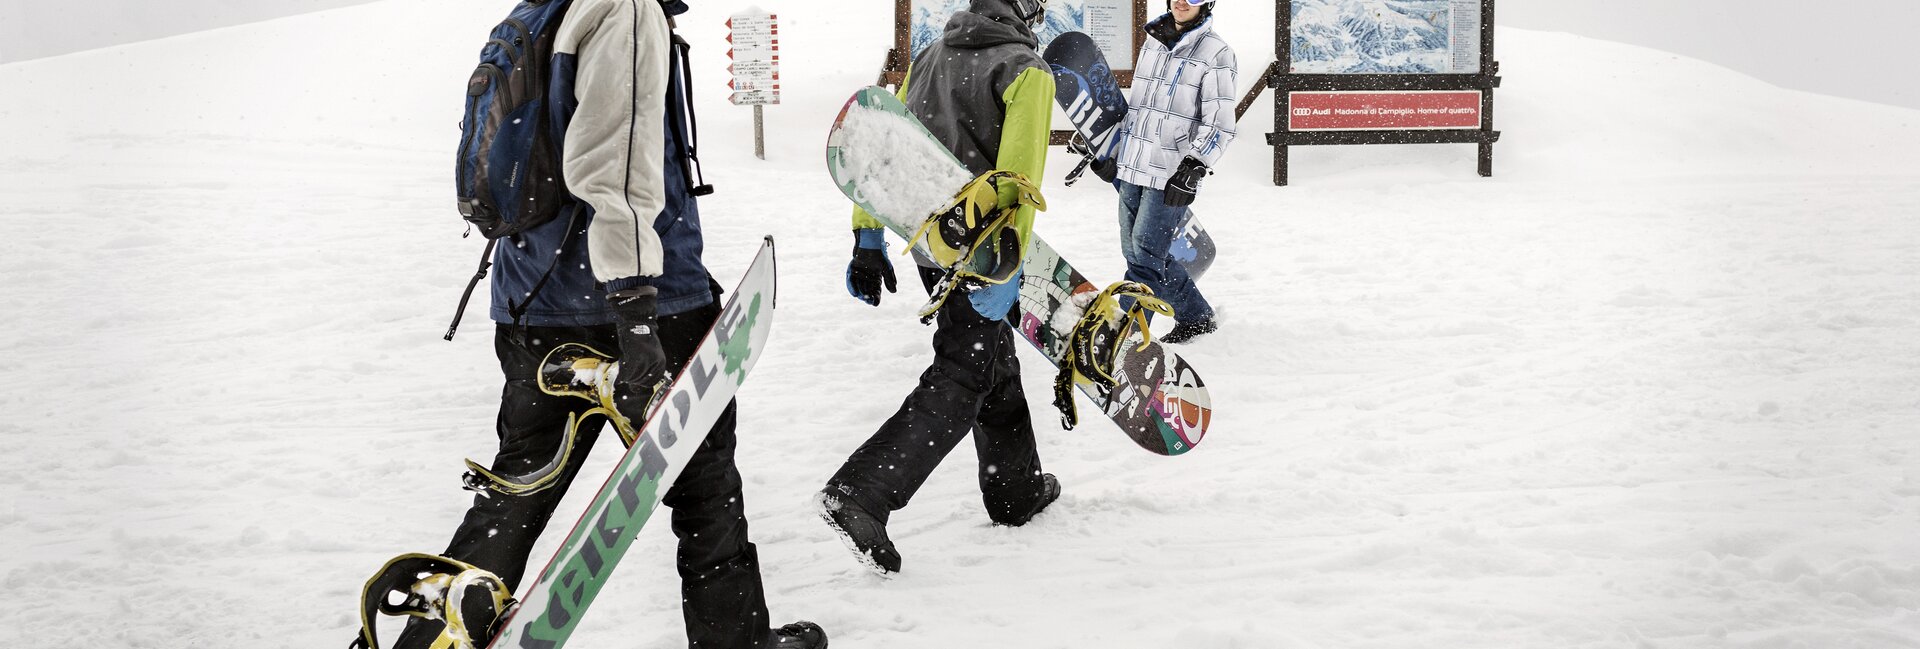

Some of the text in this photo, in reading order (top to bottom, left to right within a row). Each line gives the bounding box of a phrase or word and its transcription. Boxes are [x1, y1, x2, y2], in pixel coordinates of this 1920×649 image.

[1378, 107, 1416, 116] Campiglio.
[1417, 107, 1438, 115] Home
[1439, 107, 1447, 115] of
